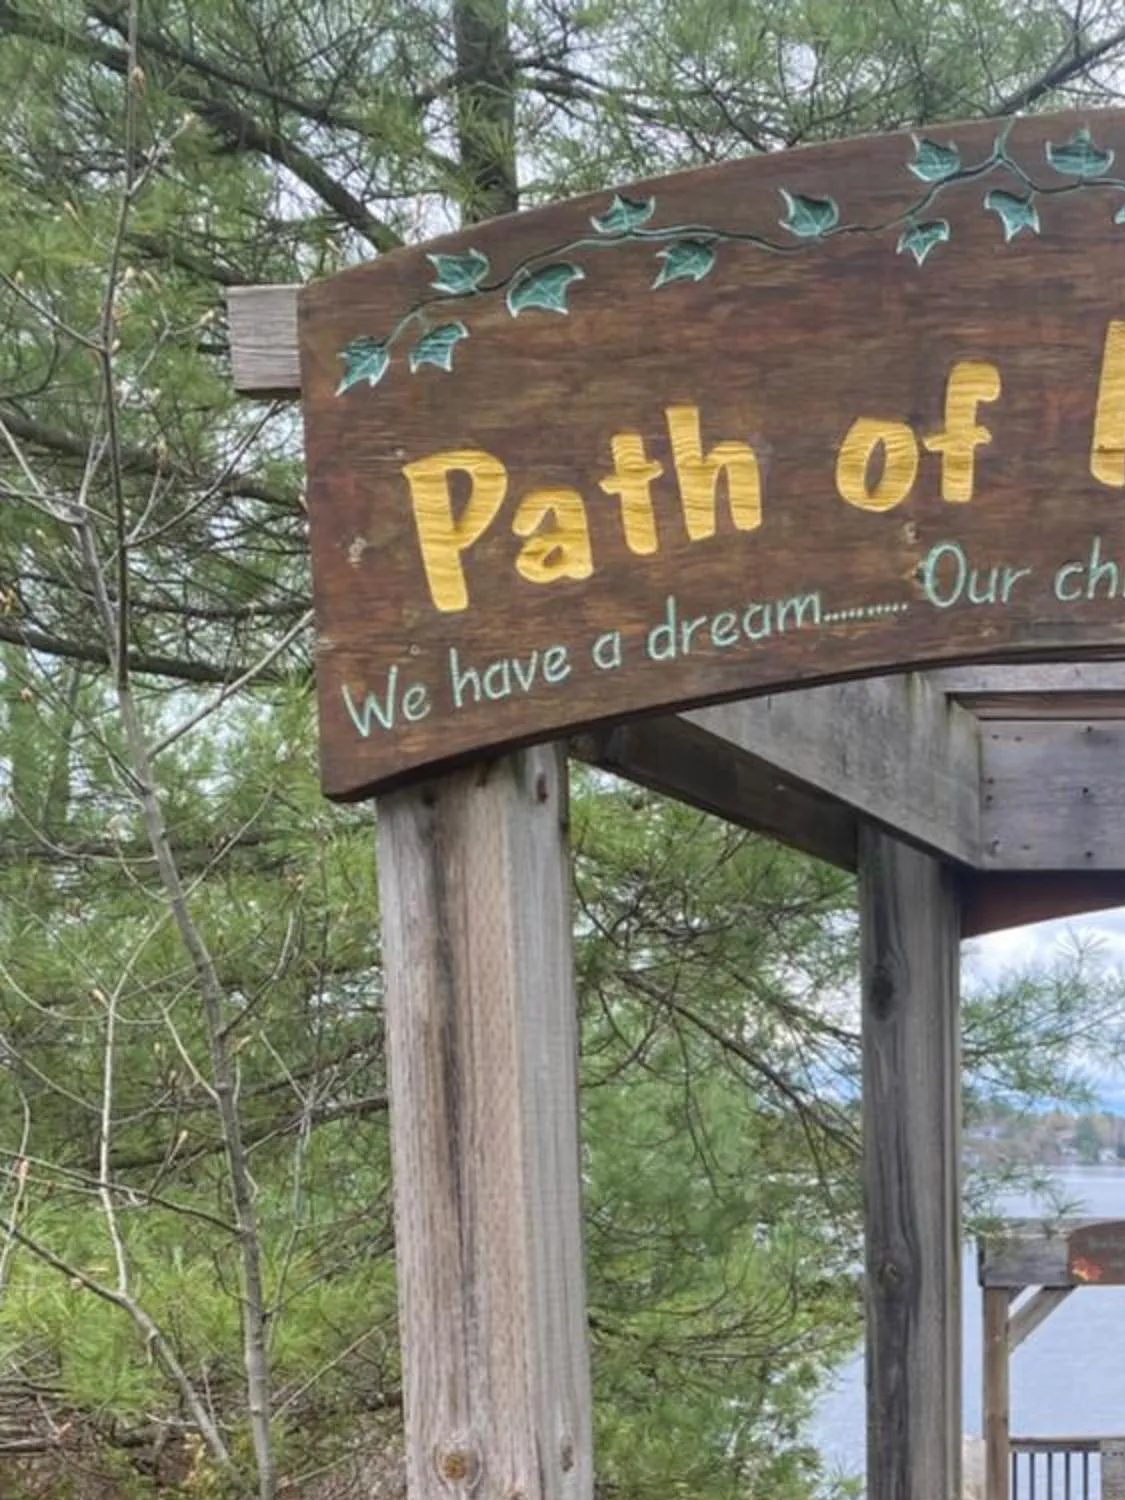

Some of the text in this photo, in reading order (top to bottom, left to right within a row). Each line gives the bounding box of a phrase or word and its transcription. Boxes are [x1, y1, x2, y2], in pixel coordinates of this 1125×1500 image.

[402, 402, 763, 612] Path
[836, 360, 1003, 513] of
[341, 664, 431, 738] We
[449, 647, 572, 708] have
[592, 631, 623, 670] a
[922, 543, 1031, 609] Our
